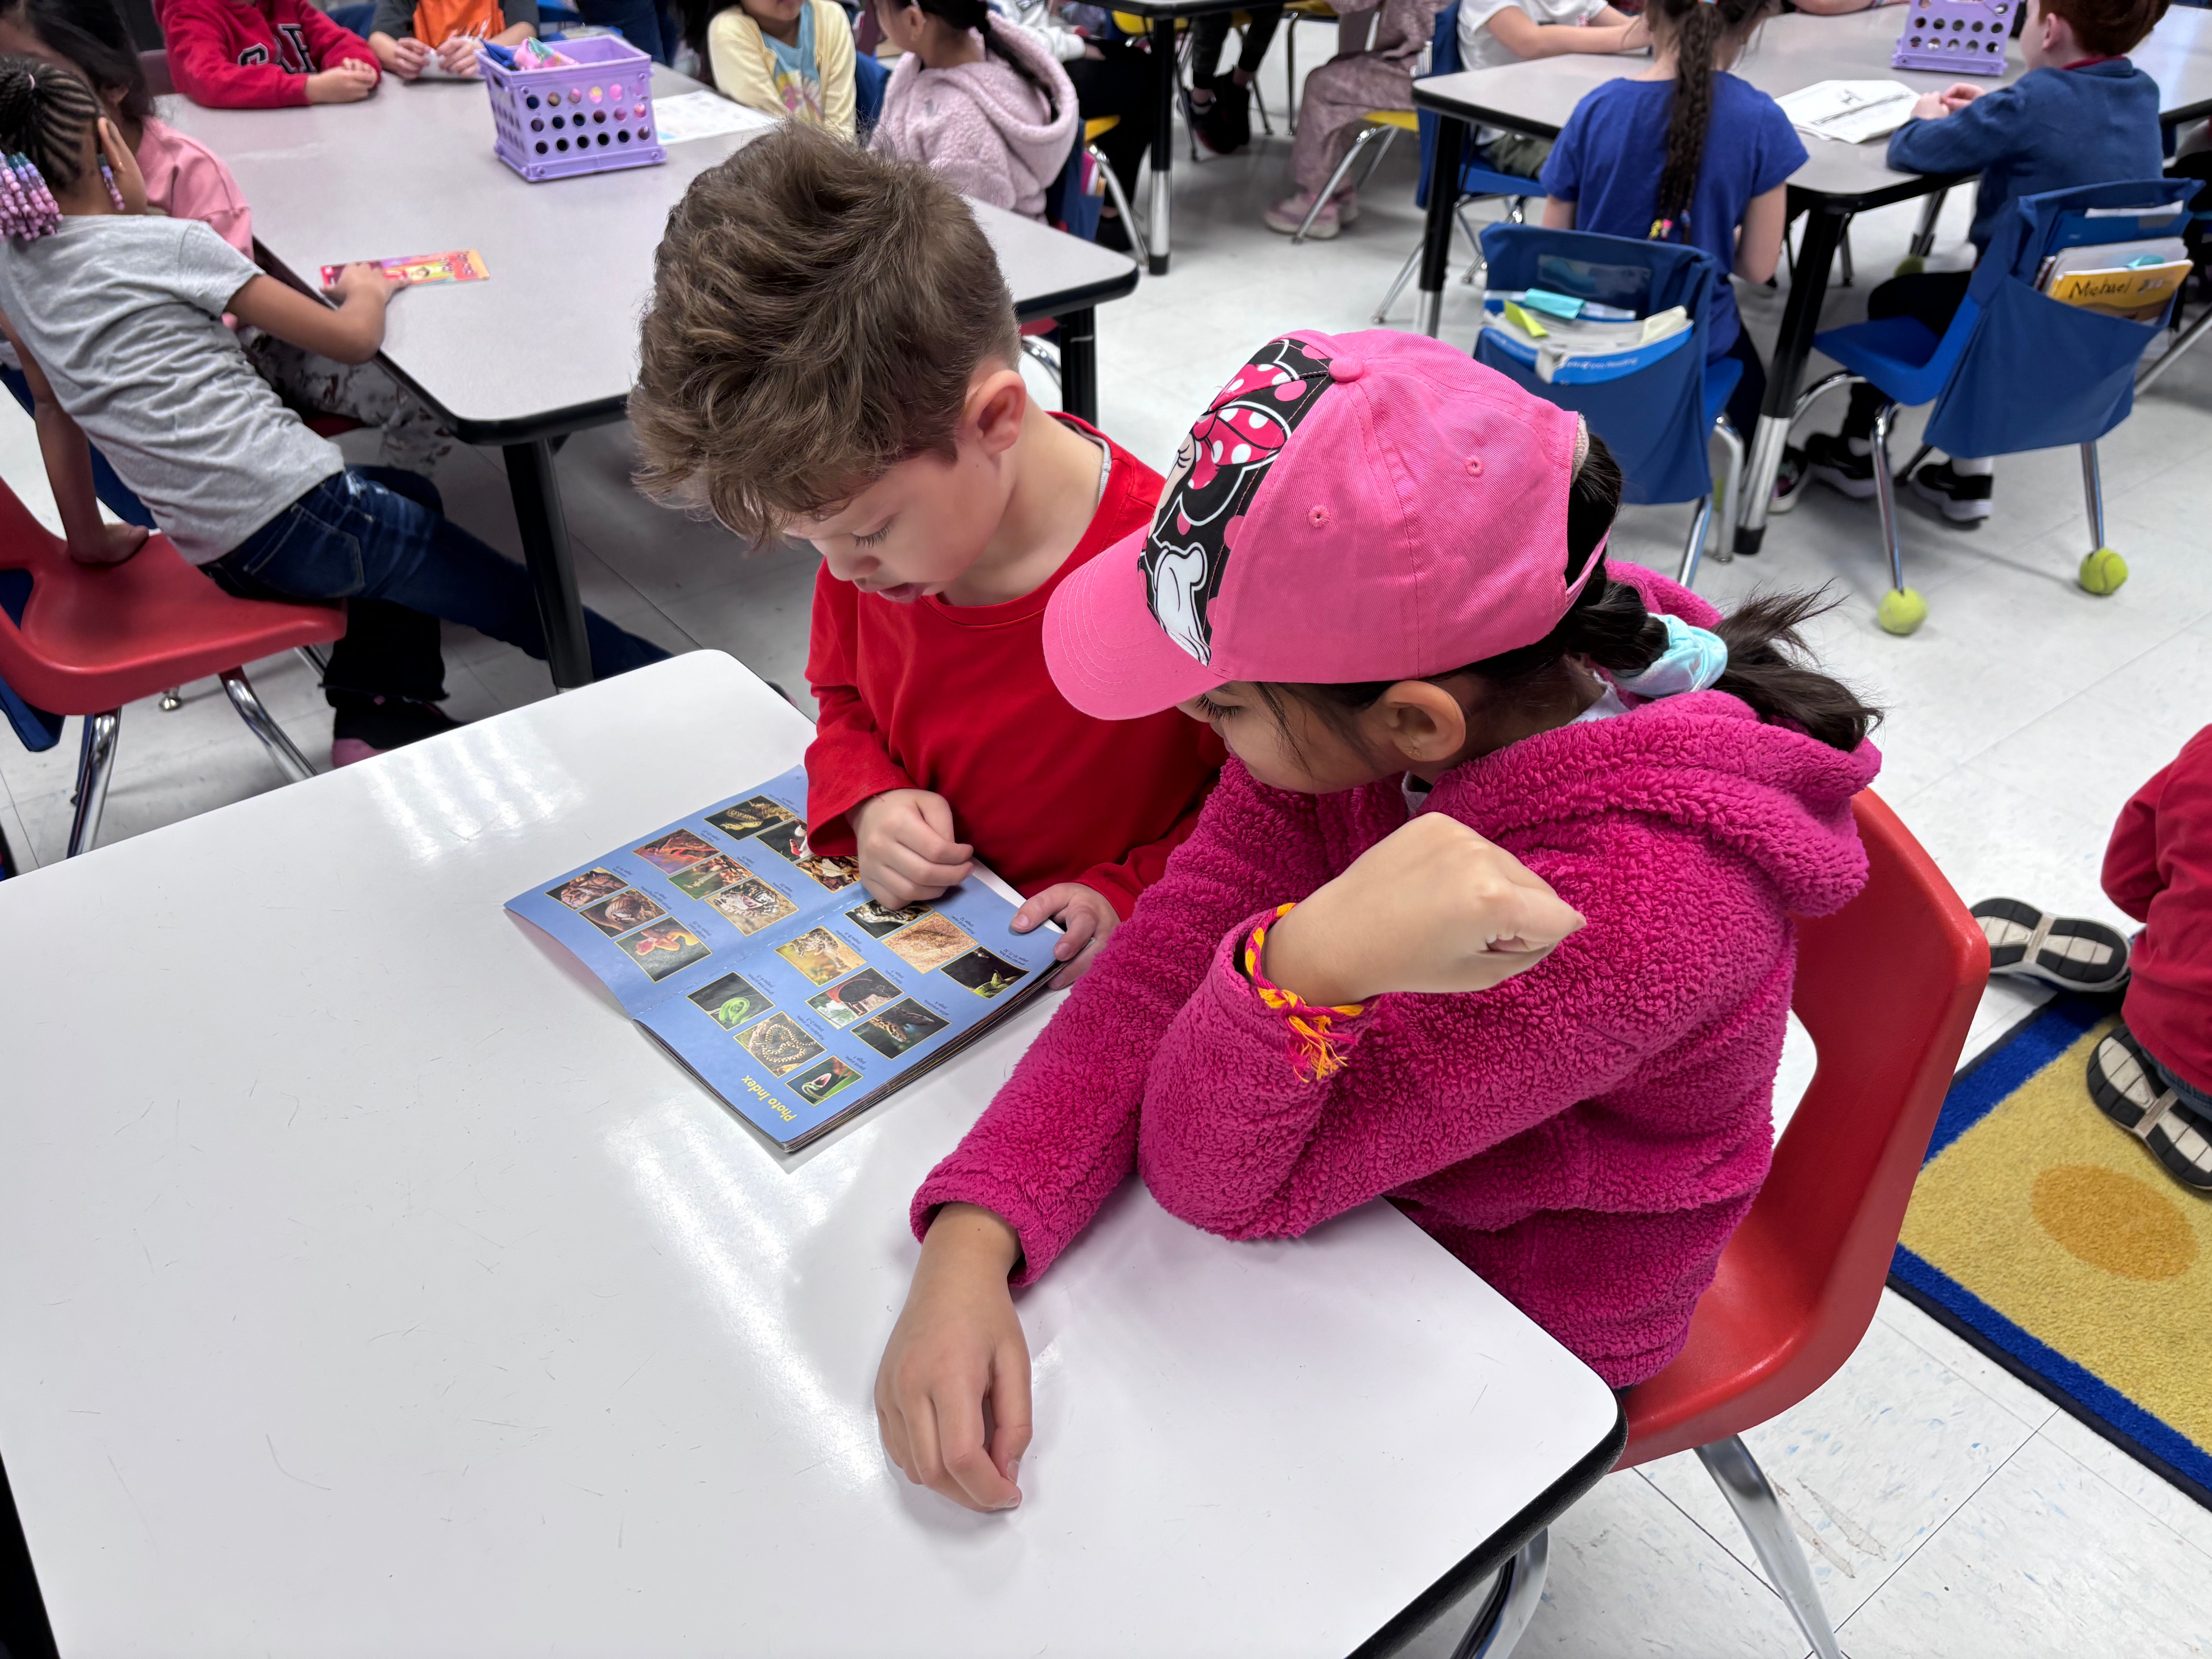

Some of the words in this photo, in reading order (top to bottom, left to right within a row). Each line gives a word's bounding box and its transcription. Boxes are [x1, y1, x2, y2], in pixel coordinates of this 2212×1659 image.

[2068, 275, 2133, 299] Michael
[809, 1027, 825, 1040] Mandarin
[812, 1022, 825, 1032] pages
[741, 1075, 771, 1101] Index
[768, 1098, 798, 1121] Photo
